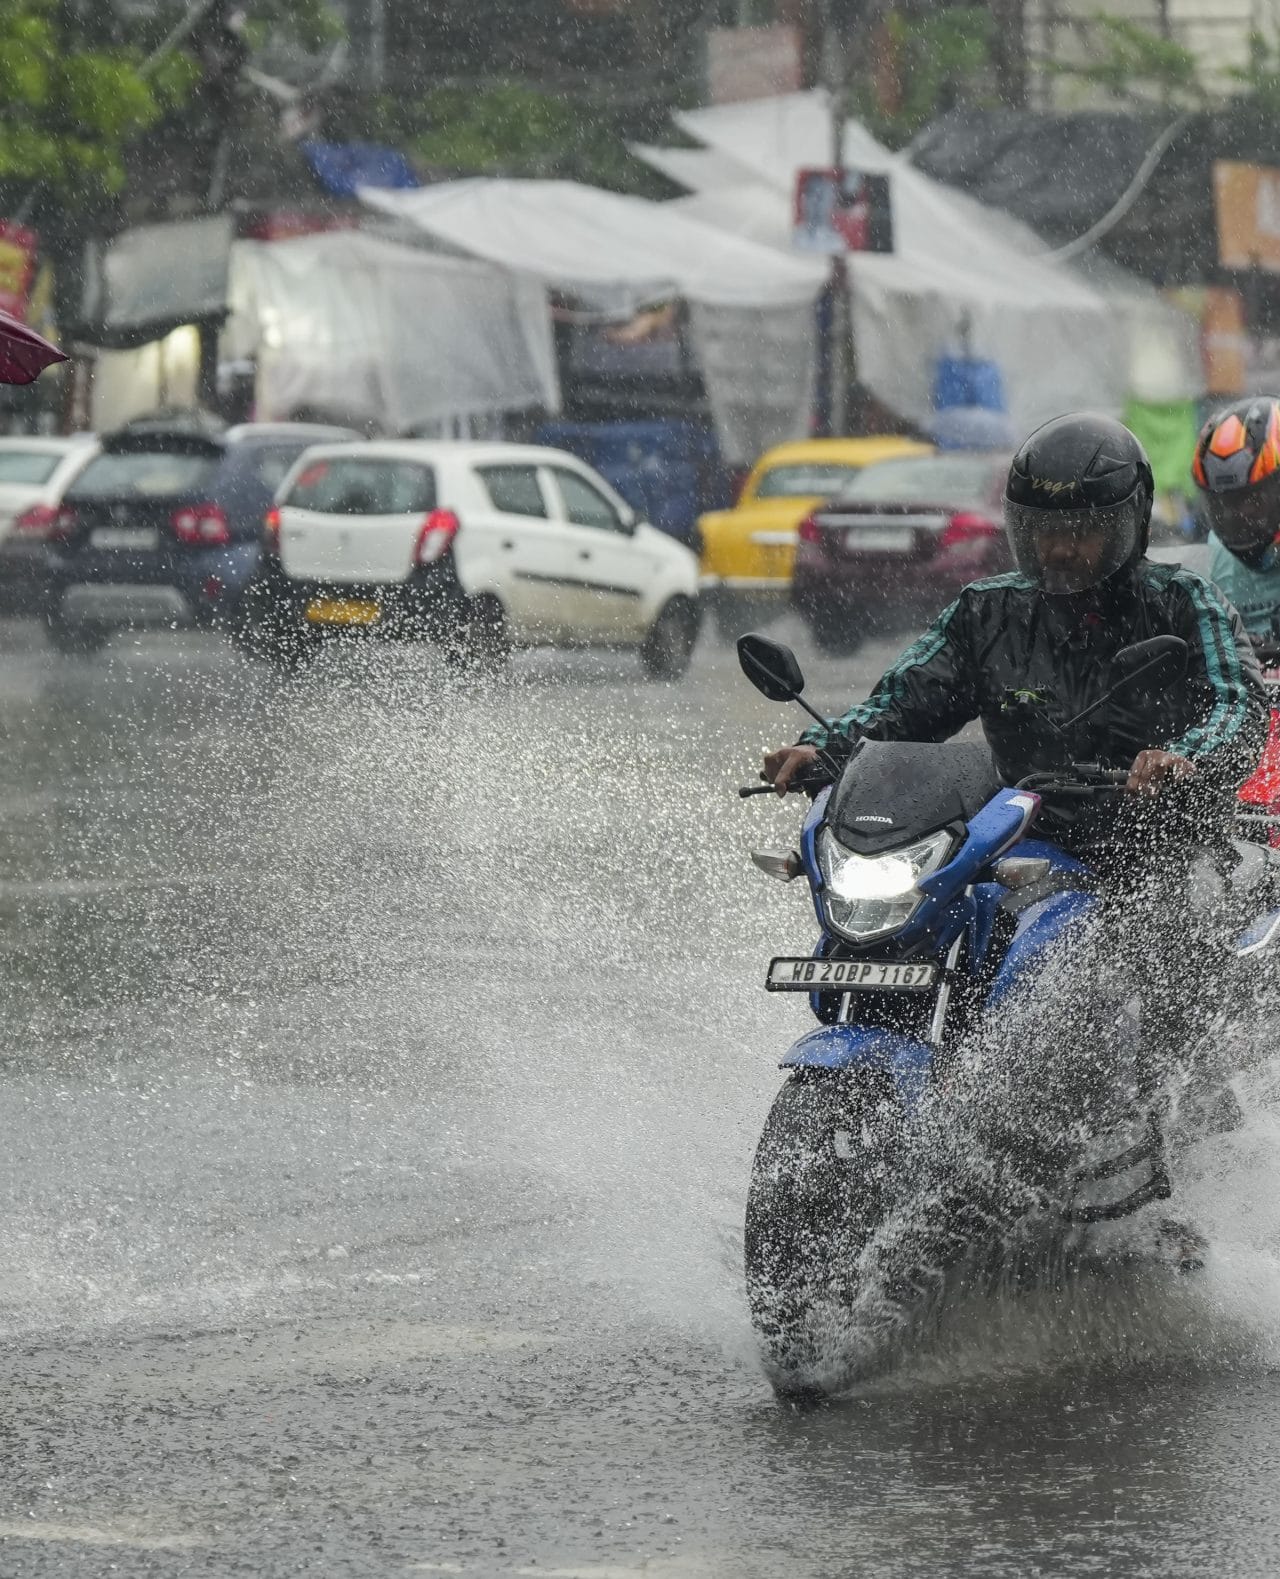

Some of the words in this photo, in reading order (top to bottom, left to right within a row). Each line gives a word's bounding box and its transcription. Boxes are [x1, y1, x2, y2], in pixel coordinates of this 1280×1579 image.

[855, 815, 893, 824] HONDA
[792, 962, 816, 982] WB
[820, 963, 872, 983] 20BP
[880, 965, 929, 985] 1167
